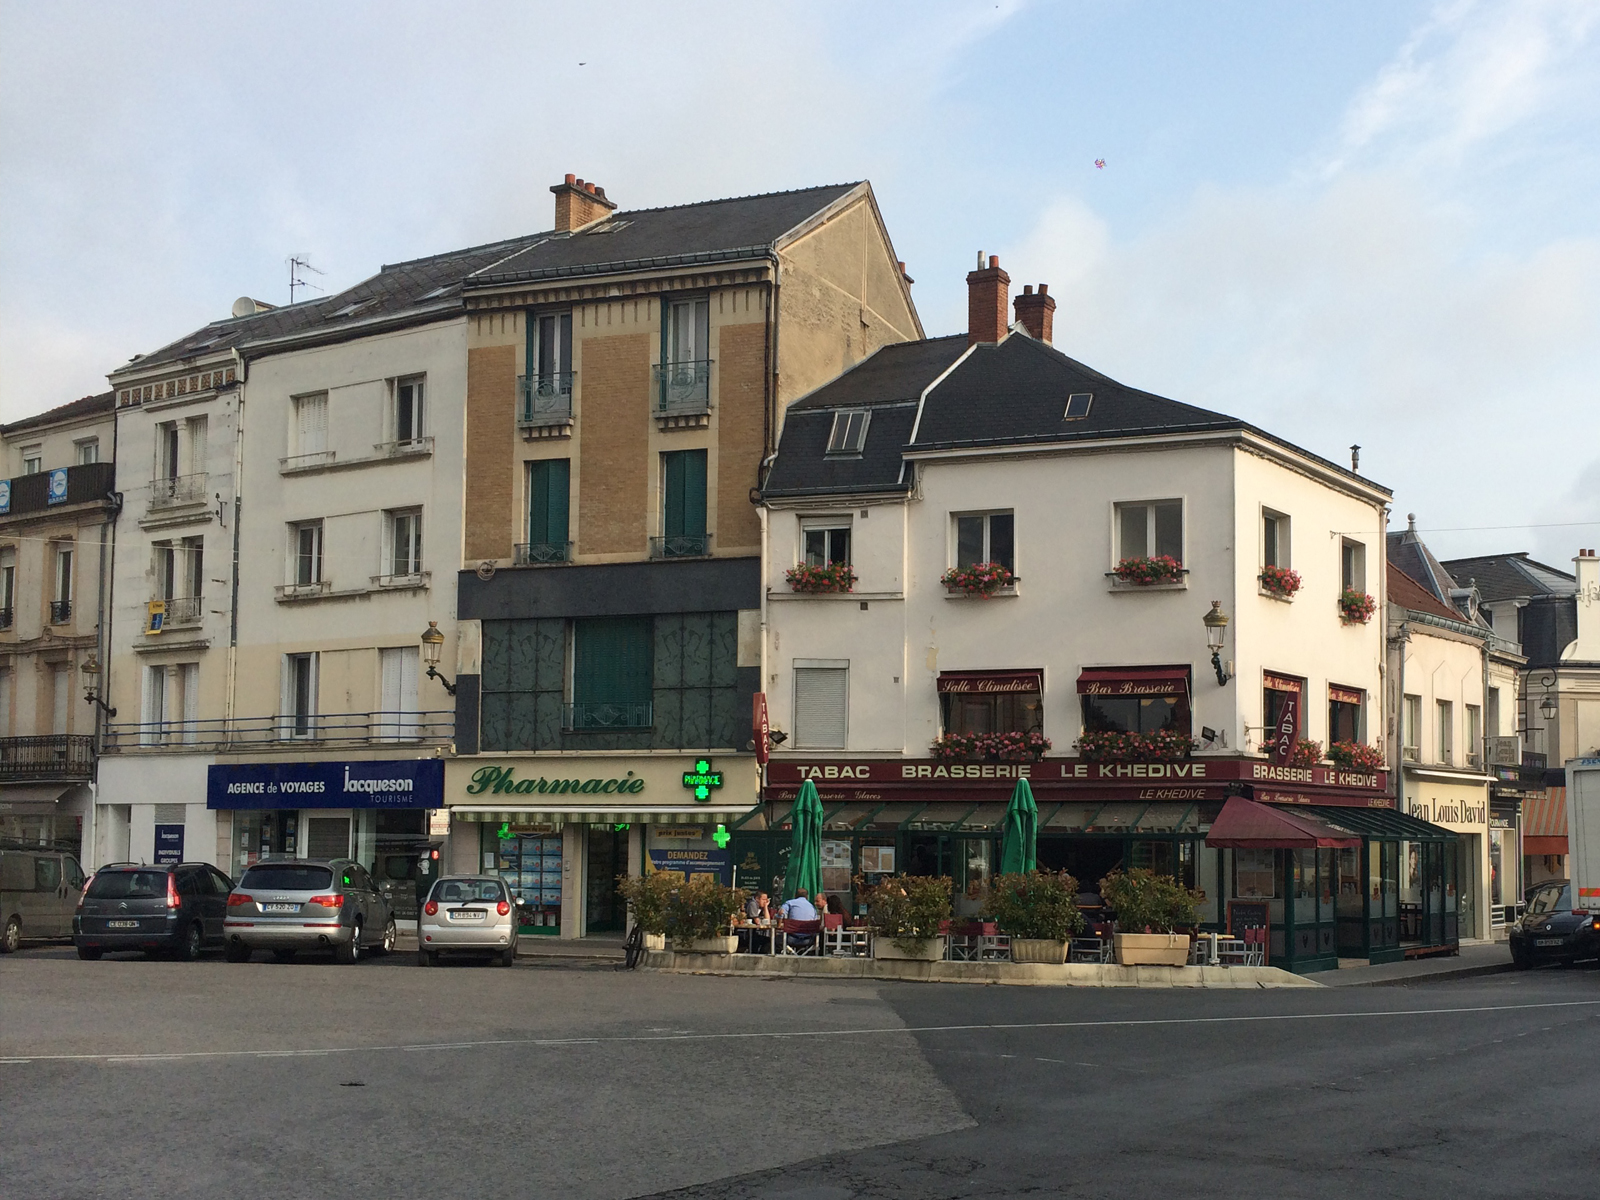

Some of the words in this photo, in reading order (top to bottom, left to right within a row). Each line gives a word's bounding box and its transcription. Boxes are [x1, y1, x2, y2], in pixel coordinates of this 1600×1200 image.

[942, 680, 971, 692] Salle
[1086, 681, 1113, 694] Bar
[1118, 681, 1175, 694] Brasserie
[761, 702, 769, 754] TABAC
[1279, 701, 1295, 756] TABAC
[797, 765, 871, 779] TABAC
[901, 765, 1032, 779] BRASSERIE
[1060, 764, 1088, 778] LE
[1099, 763, 1206, 778] KHEDIVE
[1253, 764, 1313, 782] BRASSERIE
[1324, 771, 1336, 784] LE
[1338, 772, 1378, 788] KHEDIVE
[227, 782, 265, 794] AGENCE
[266, 781, 278, 794] de
[279, 780, 326, 794] VOYAGES
[466, 766, 645, 795] Pharmacie
[370, 794, 414, 803] TOURISME
[778, 790, 797, 799] Bar
[818, 790, 846, 799] asserie
[854, 790, 882, 800] Glaces
[1139, 789, 1155, 799] LE
[1155, 788, 1207, 799] KHEDIVE
[1406, 796, 1431, 822] Jean
[1431, 797, 1459, 824] Louis
[1459, 799, 1486, 824] David
[658, 829, 673, 837] prix
[667, 851, 709, 860] DEMANDEZ
